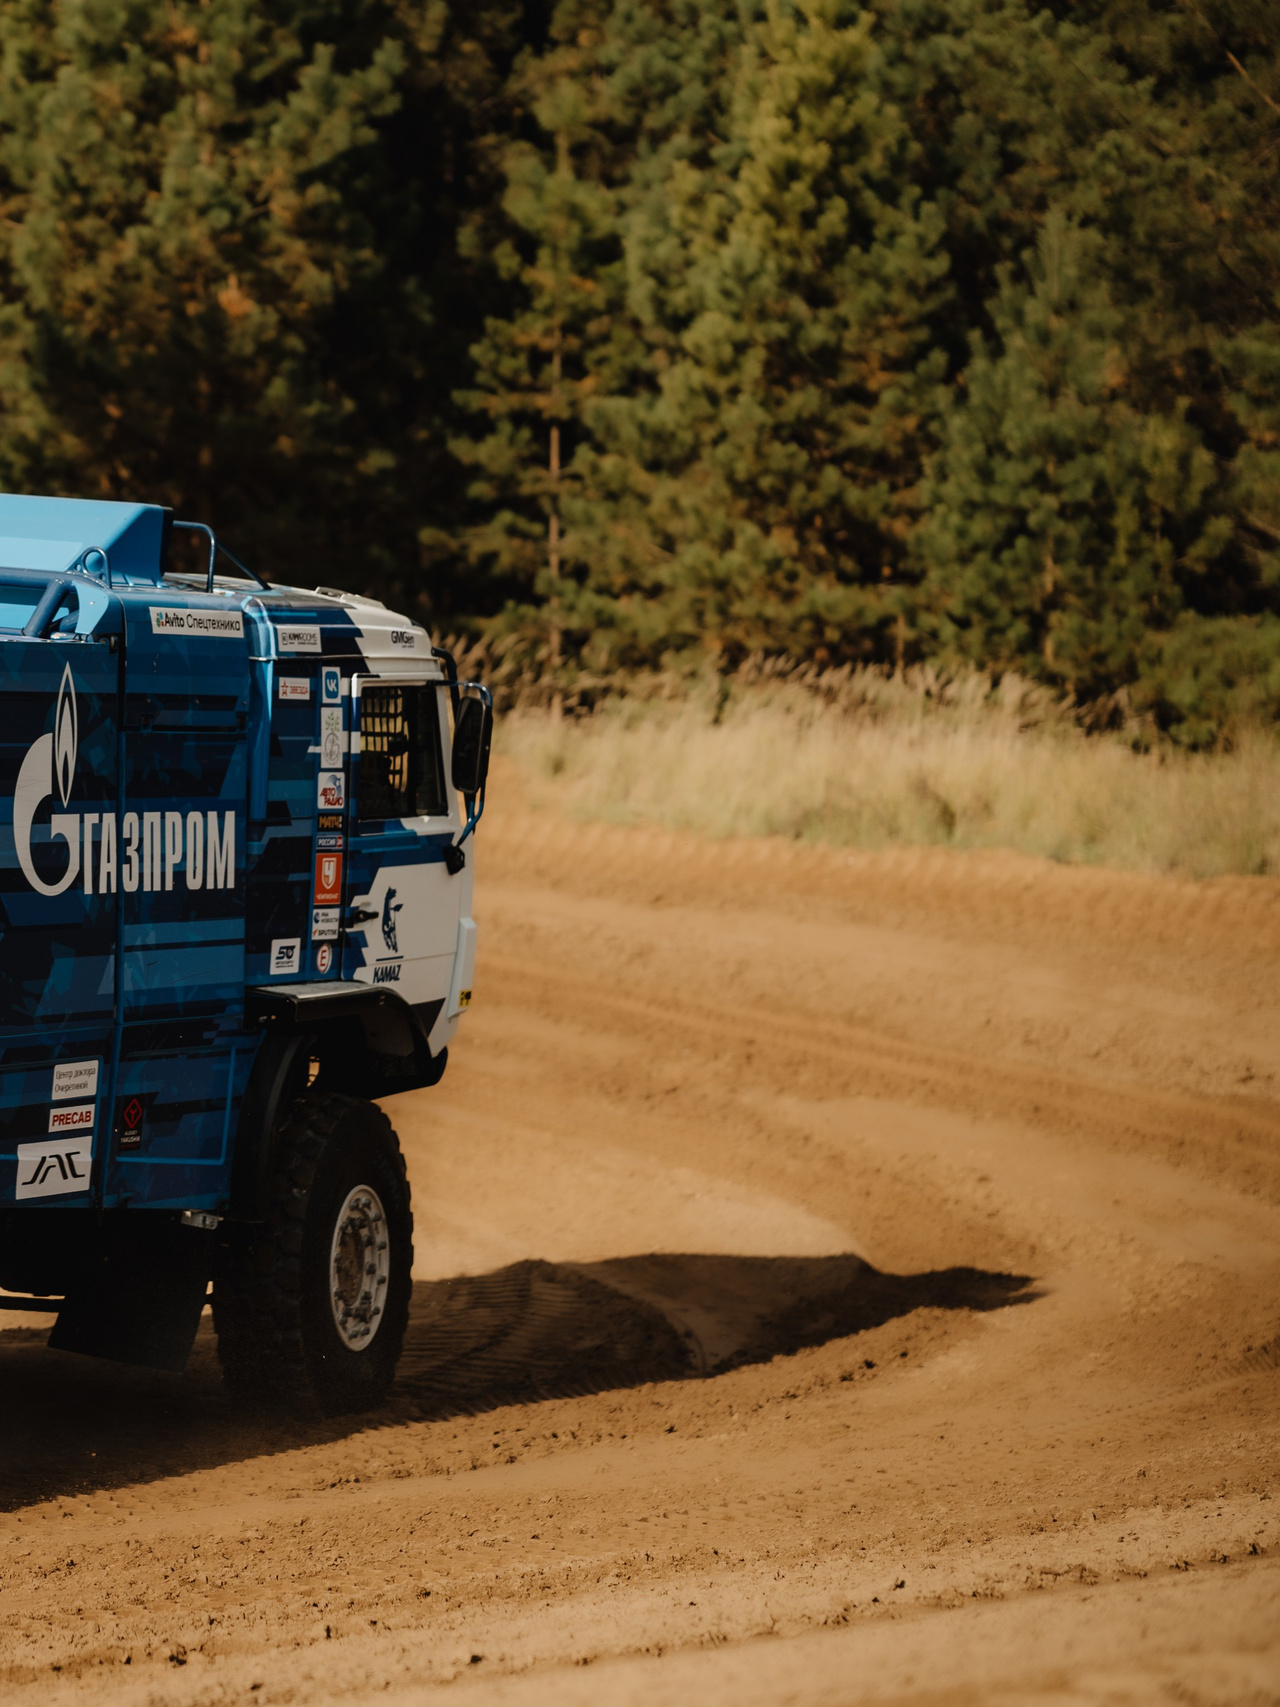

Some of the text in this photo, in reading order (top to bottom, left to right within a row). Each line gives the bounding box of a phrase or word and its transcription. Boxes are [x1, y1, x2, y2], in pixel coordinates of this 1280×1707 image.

[164, 613, 240, 632] Avito Спецтехника
[326, 678, 337, 692] VK
[83, 810, 236, 895] ГАЗПРОМ
[373, 964, 402, 983] KAMAZ
[51, 1110, 92, 1127] PRECAB
[21, 1151, 86, 1186] JAC
